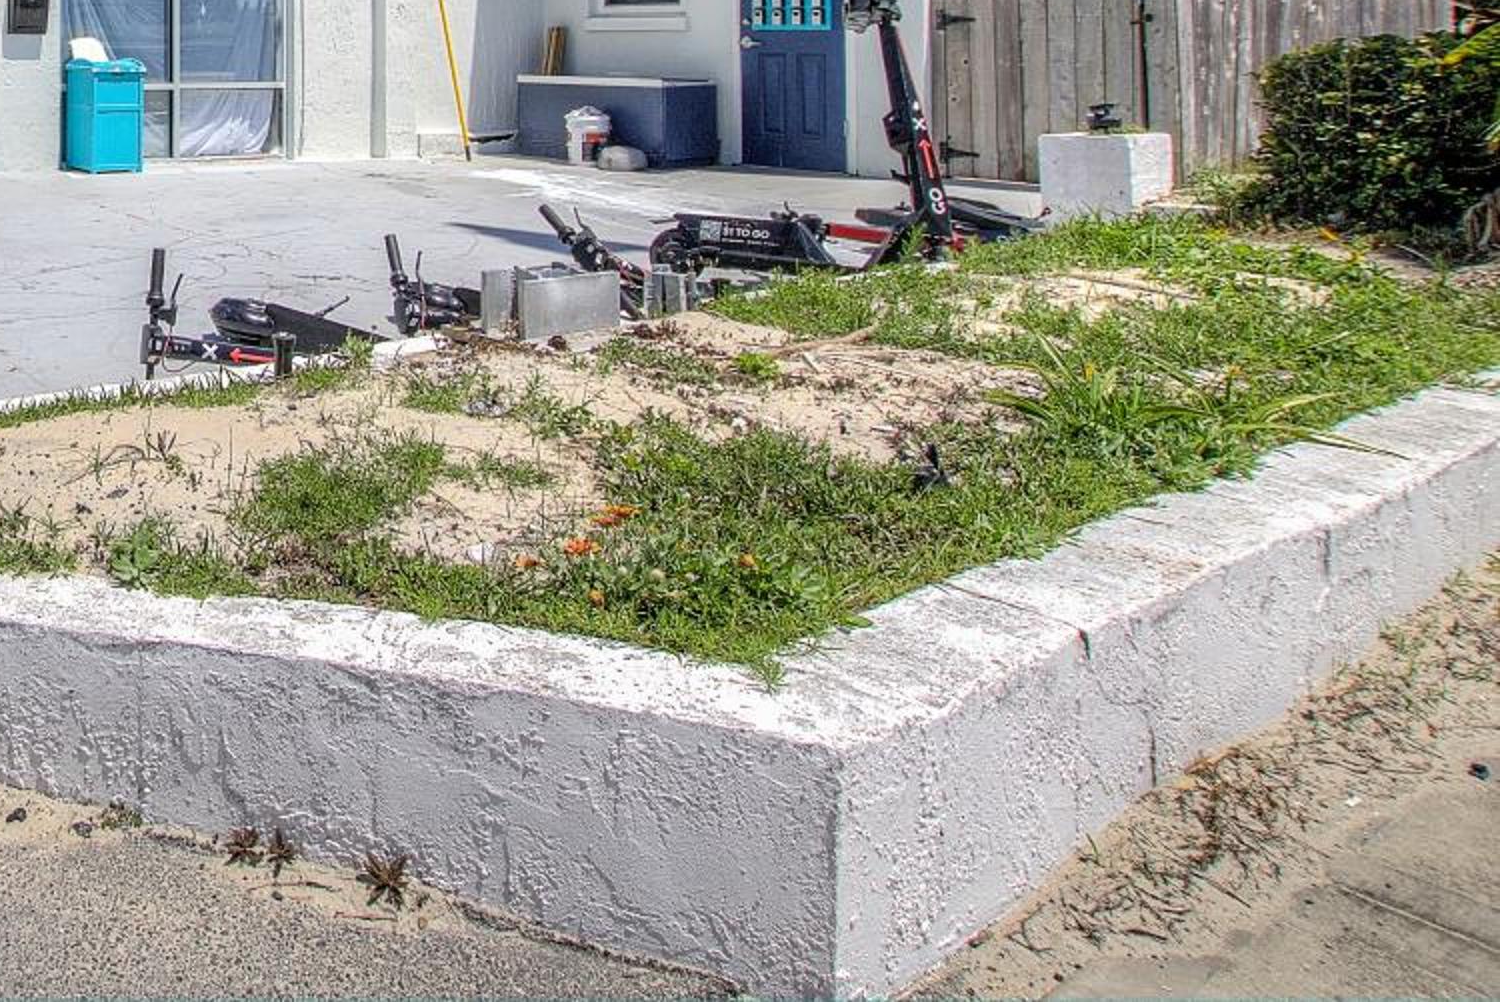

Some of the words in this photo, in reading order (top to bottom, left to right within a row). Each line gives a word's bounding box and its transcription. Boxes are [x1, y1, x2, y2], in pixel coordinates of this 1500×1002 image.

[929, 187, 946, 215] GO
[736, 228, 750, 237] TO
[752, 229, 770, 239] GO
